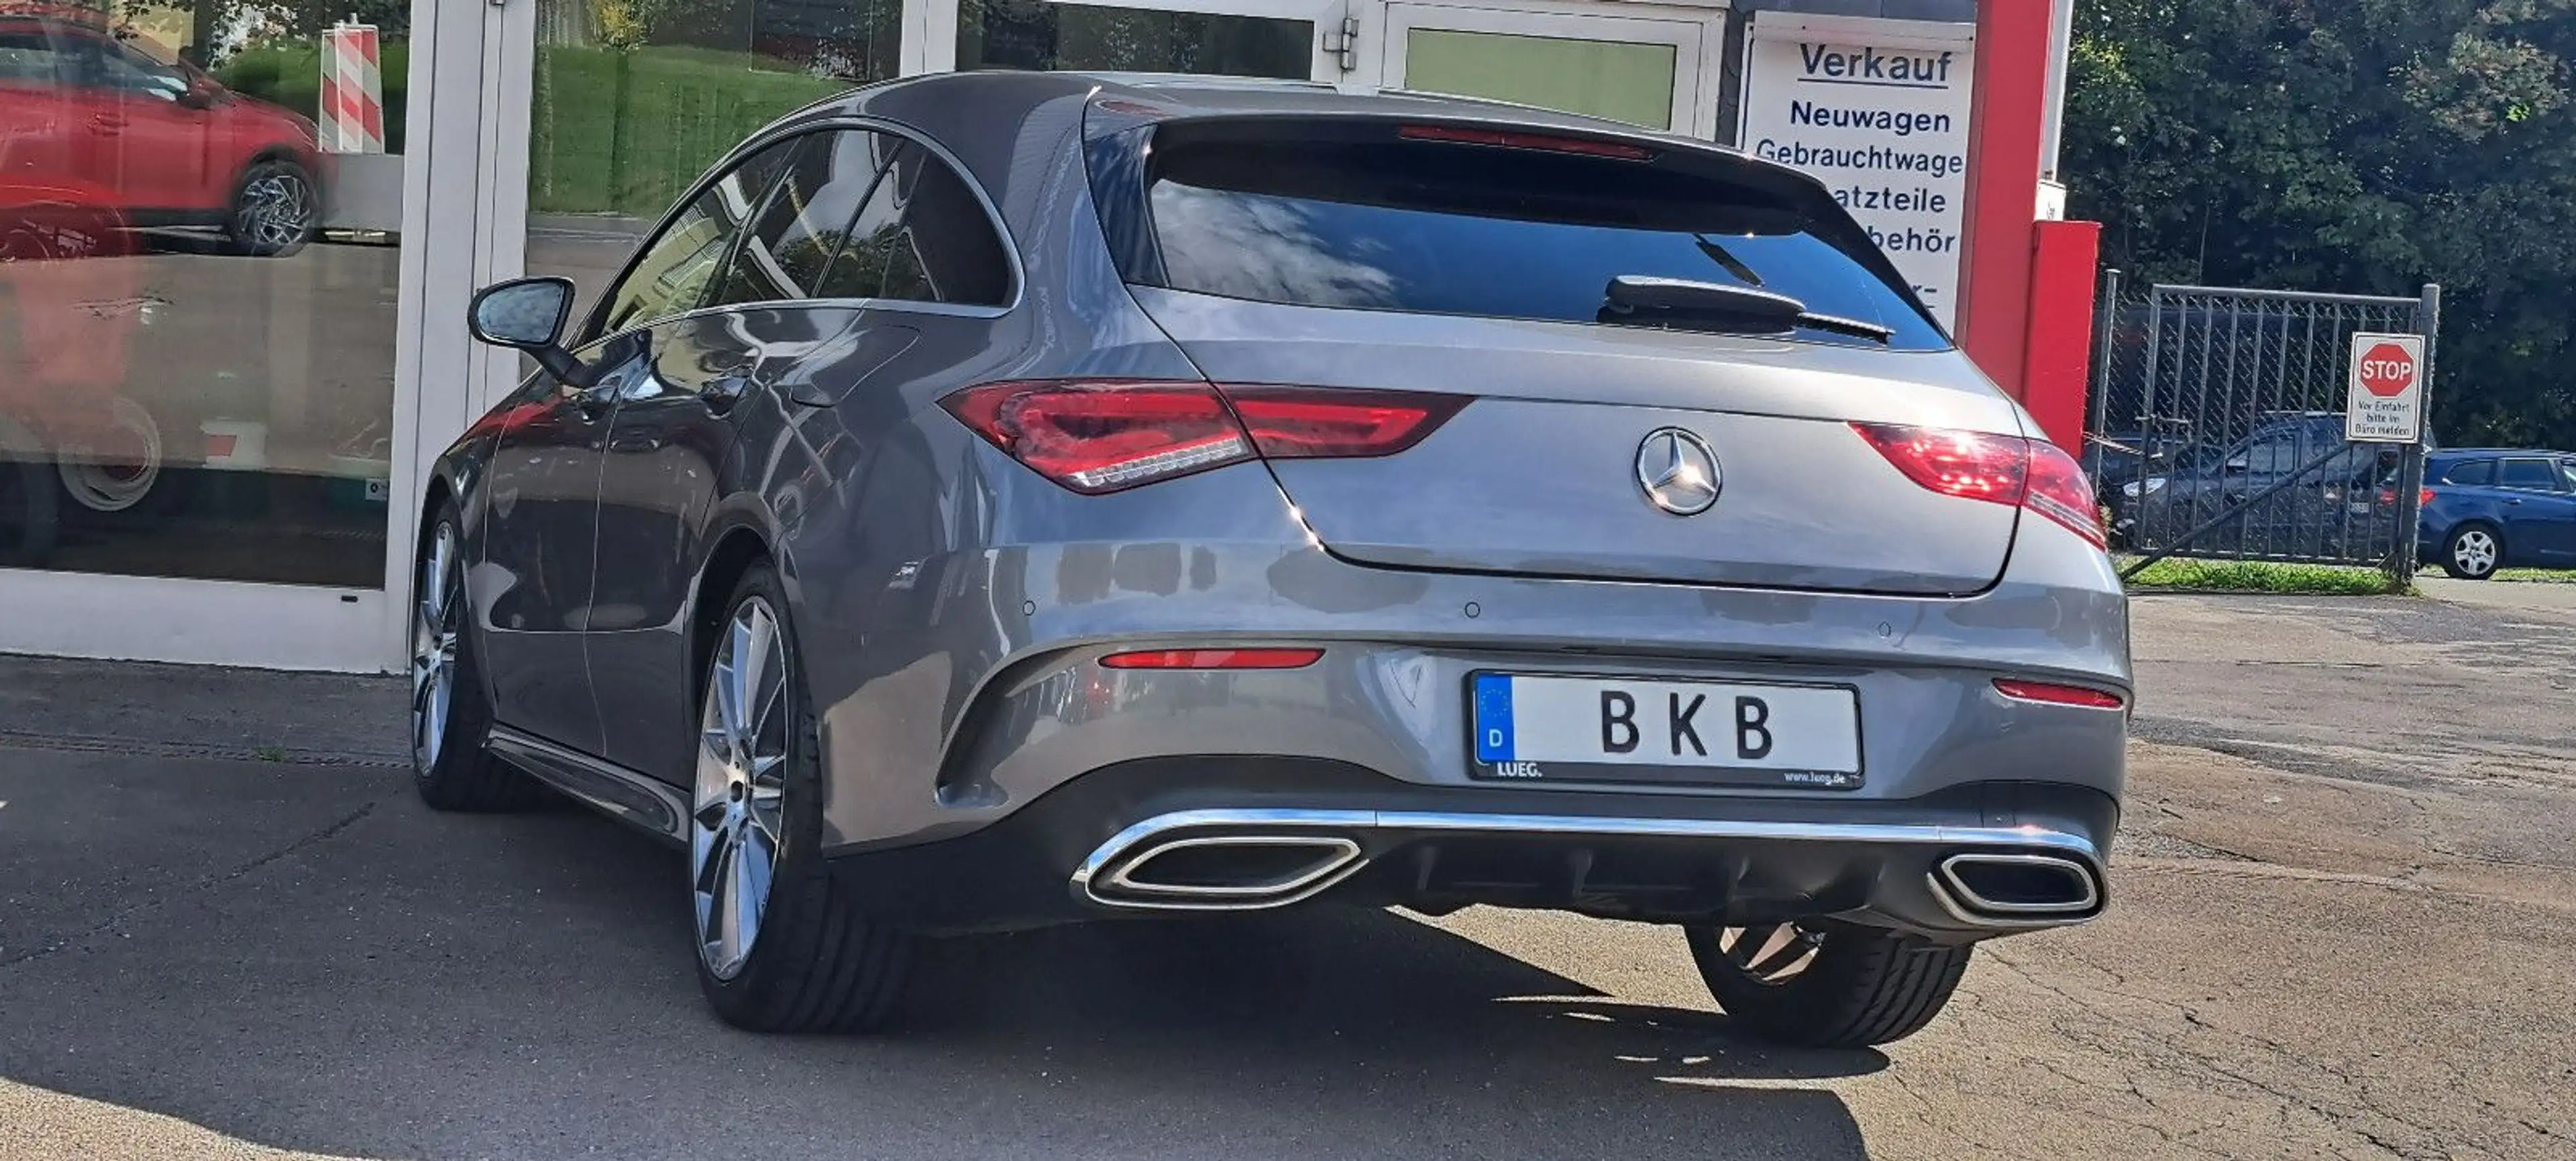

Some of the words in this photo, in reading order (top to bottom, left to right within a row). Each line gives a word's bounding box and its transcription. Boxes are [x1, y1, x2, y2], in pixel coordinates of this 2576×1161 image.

[1800, 44, 1952, 83] Verkauf
[1790, 101, 1951, 136] Neuwagen
[1756, 138, 1963, 178] Gebrauchtwage
[1834, 185, 1946, 213] atzteile
[1868, 225, 1955, 252] behör
[2362, 360, 2411, 381] STOP
[2359, 401, 2371, 410] Vor
[1489, 729, 1503, 747] D
[1497, 762, 1542, 777] LUEG.
